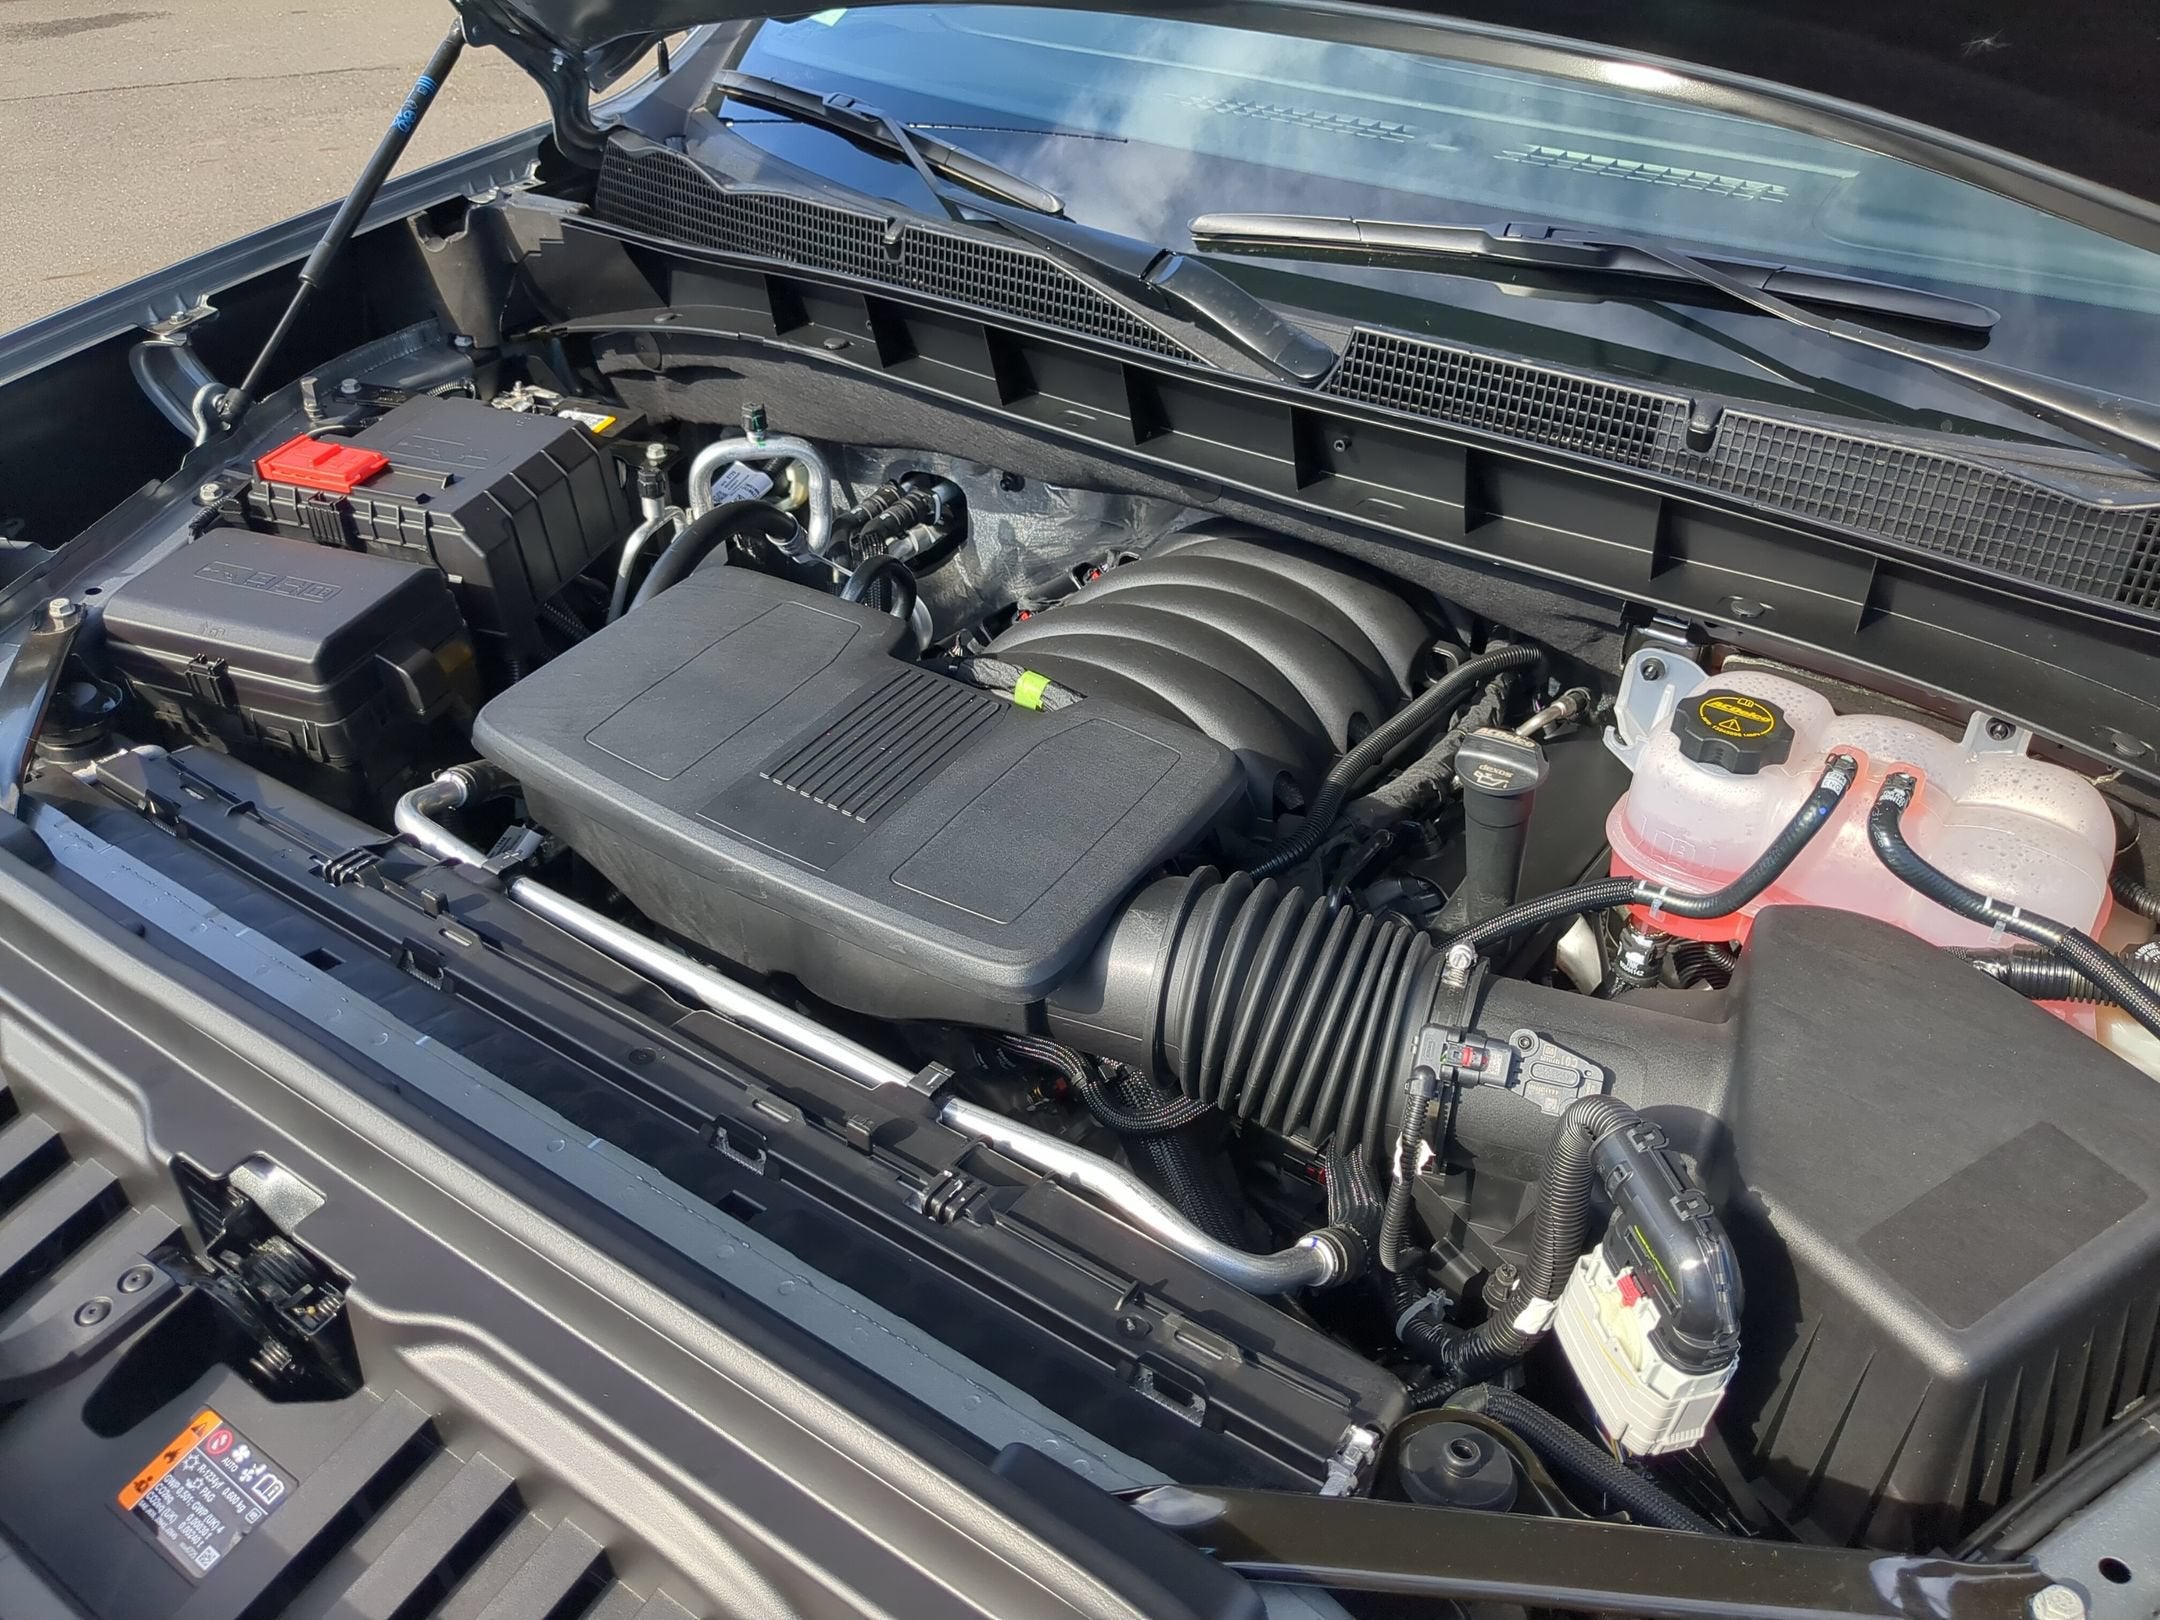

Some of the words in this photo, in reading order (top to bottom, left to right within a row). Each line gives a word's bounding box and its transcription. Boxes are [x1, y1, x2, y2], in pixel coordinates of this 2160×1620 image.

[1707, 701, 1771, 722] ACDelco
[1479, 764, 1515, 778] dexos
[221, 1456, 239, 1473] AUTO
[163, 1474, 180, 1491] GWP
[191, 1499, 208, 1516] GWP
[199, 1487, 216, 1503] PAG
[235, 1499, 247, 1514] kg
